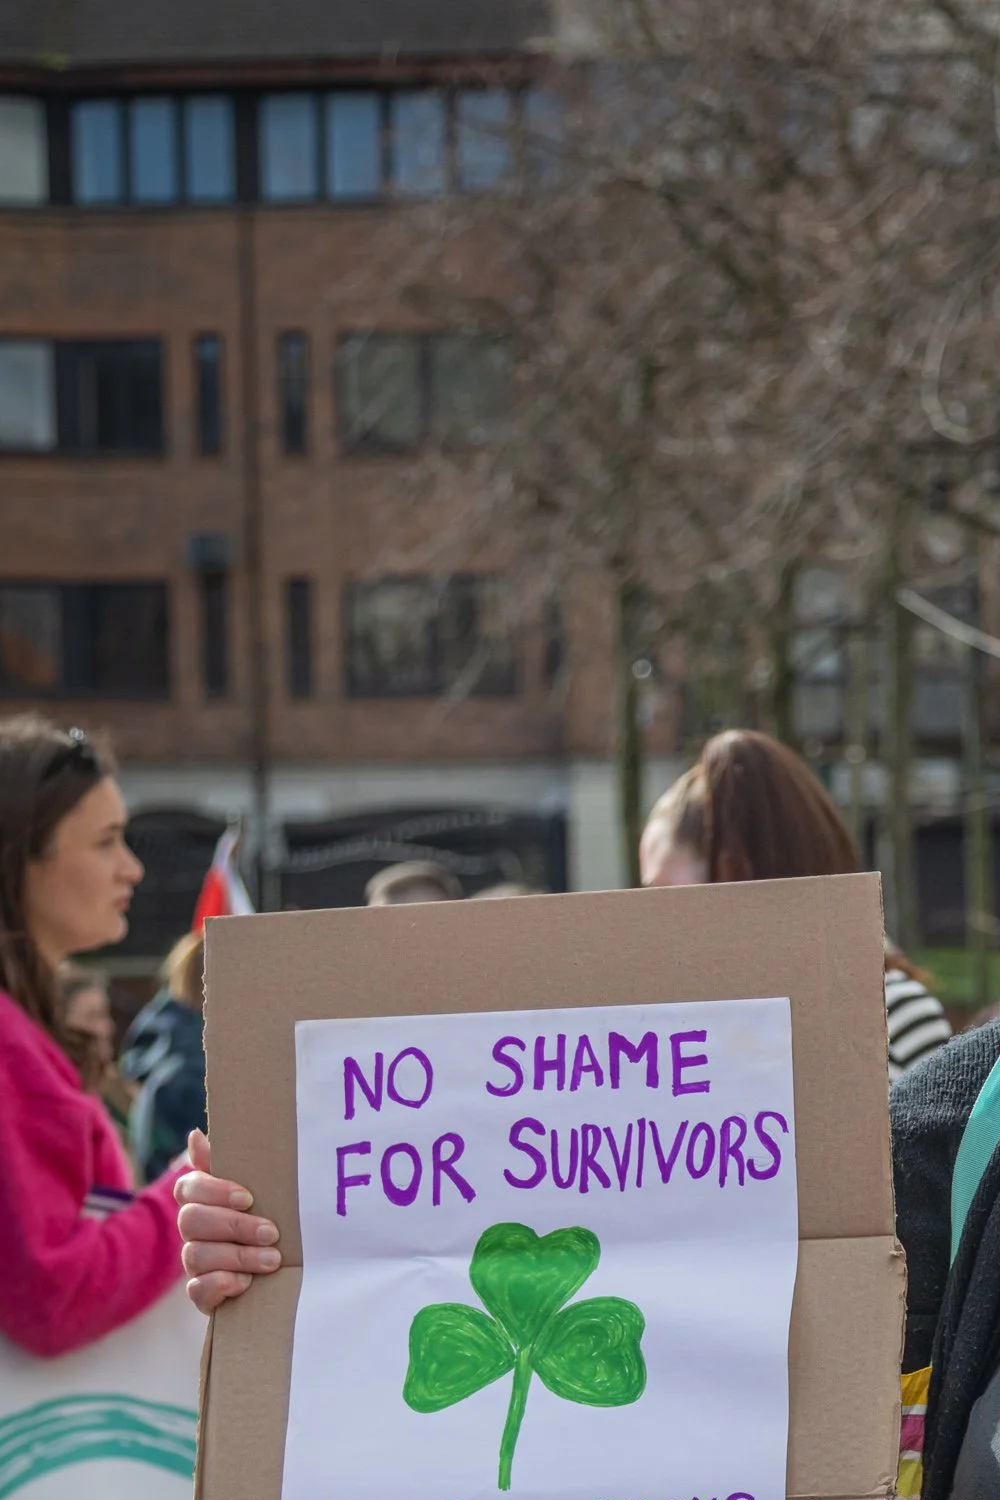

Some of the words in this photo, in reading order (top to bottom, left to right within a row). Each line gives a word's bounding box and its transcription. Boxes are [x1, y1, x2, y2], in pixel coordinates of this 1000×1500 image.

[343, 1046, 434, 1121] NO
[485, 1029, 711, 1098] SHAME
[335, 1132, 478, 1217] FOR
[502, 1110, 790, 1194] SURVIVORS
